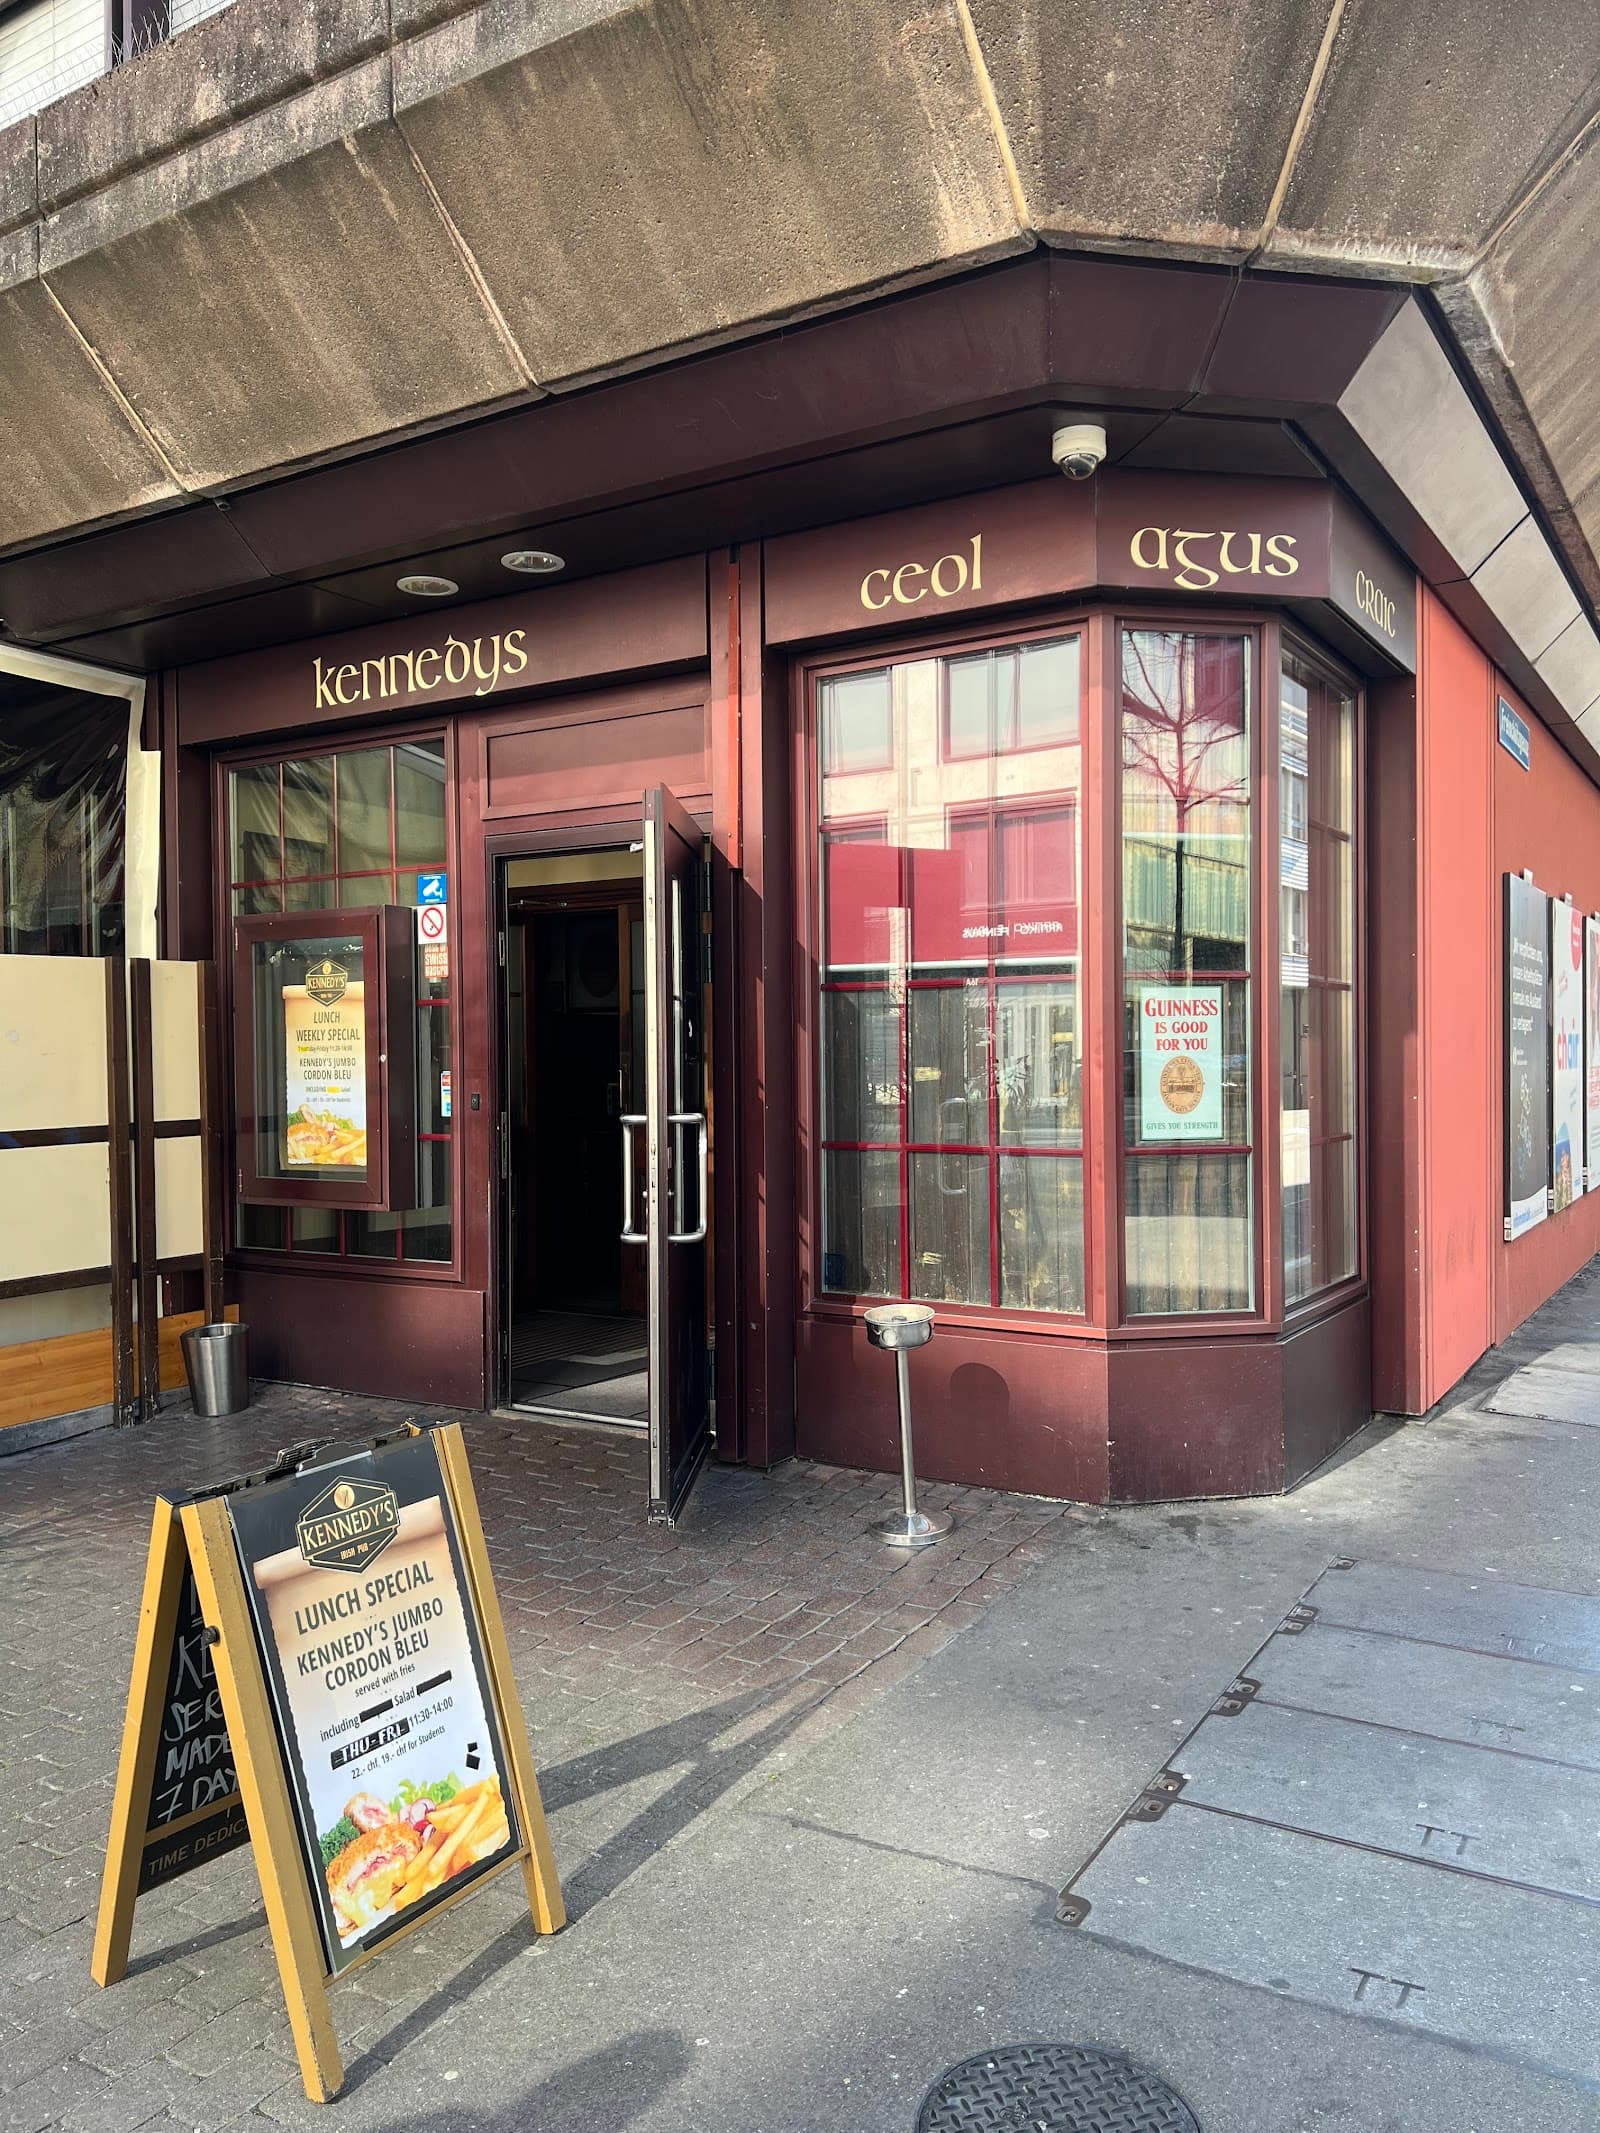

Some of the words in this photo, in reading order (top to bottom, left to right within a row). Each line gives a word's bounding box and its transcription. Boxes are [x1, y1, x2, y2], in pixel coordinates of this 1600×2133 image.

[860, 533, 983, 610] ceol
[1130, 527, 1300, 590] agus
[313, 1011, 341, 1024] LUNCH
[1144, 997, 1219, 1017] GUINNESS
[296, 1029, 326, 1041] WEEKLY
[327, 1028, 360, 1041] SPECIAL
[1154, 1021, 1168, 1034] IS
[1172, 1020, 1208, 1034] GOOD
[1156, 1038, 1181, 1051] FOR
[1182, 1037, 1208, 1051] YOU
[299, 1058, 332, 1067] KENNEDY'S
[333, 1057, 356, 1069] JUMBO
[303, 1070, 332, 1080] CORDON
[334, 1069, 352, 1080] BLEU
[1146, 1122, 1167, 1130] GIVES
[1168, 1122, 1181, 1130] YOU
[1183, 1121, 1218, 1130] STRENGTH
[302, 1500, 394, 1551] KENNEDY'S
[340, 1548, 356, 1561] IRISH
[357, 1543, 369, 1555] PUB
[294, 1588, 362, 1636] LUNCH
[365, 1560, 434, 1607] SPECIAL
[297, 1620, 389, 1676] KENNEDY'S
[392, 1597, 443, 1641] JUMBO
[325, 1645, 392, 1691] CORDON
[394, 1628, 429, 1661] BLEU
[354, 1677, 381, 1697] served
[382, 1668, 399, 1686] with
[399, 1663, 416, 1676] fries
[319, 1716, 360, 1742] including
[394, 1688, 416, 1706] Salad
[409, 1696, 454, 1728] 11:30-14:00
[396, 1746, 408, 1757] chf
[407, 1740, 418, 1751] for
[418, 1725, 446, 1746] Students
[156, 1782, 184, 1823] 7
[148, 1844, 191, 1876] TIME
[1349, 1967, 1427, 2010] TT
